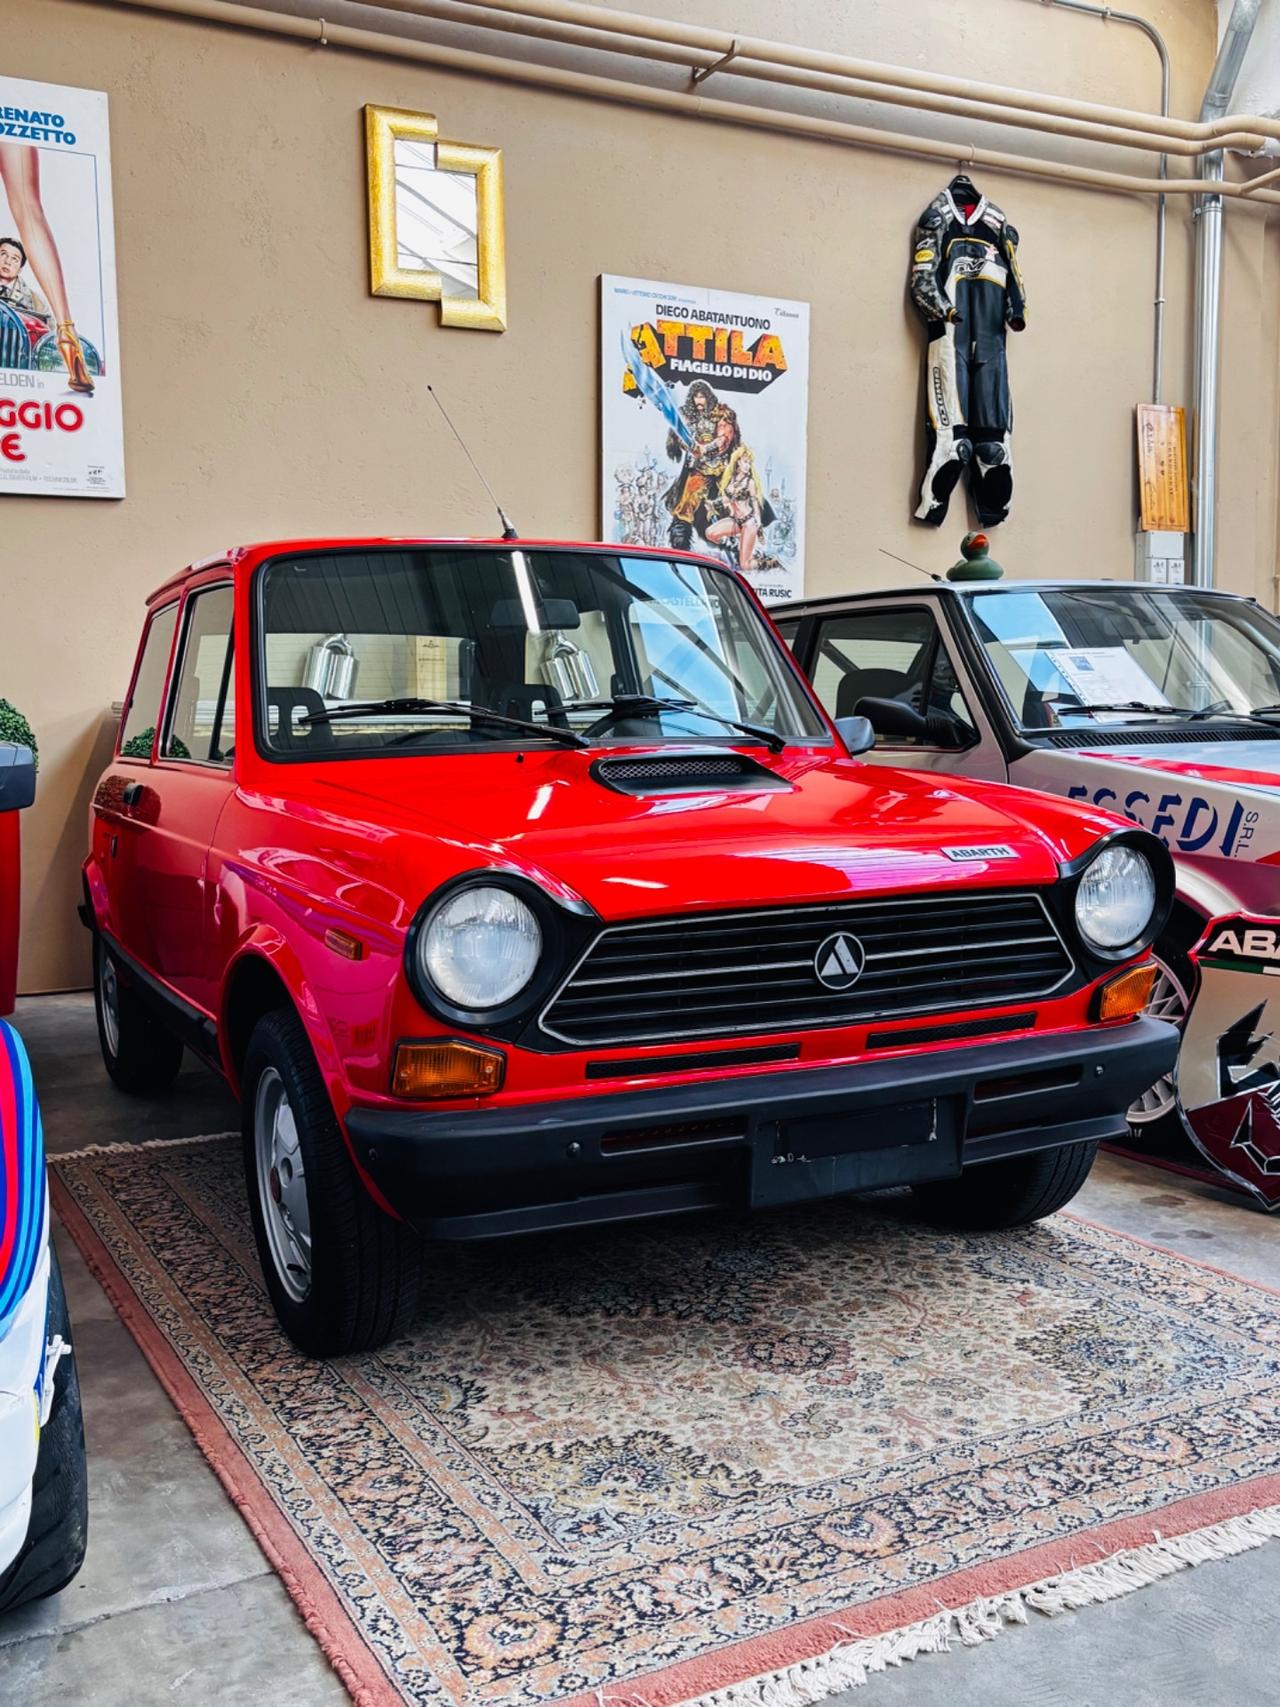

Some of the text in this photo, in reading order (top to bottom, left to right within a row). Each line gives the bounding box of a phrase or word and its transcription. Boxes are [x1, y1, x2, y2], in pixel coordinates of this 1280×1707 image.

[655, 304, 690, 319] DIEGO
[690, 309, 771, 330] ABATANTUONO
[623, 319, 788, 386] ATTILA
[670, 358, 773, 382] FLAGELLO DI DIO
[951, 847, 1010, 858] ABARTH
[1208, 929, 1280, 960] AB
